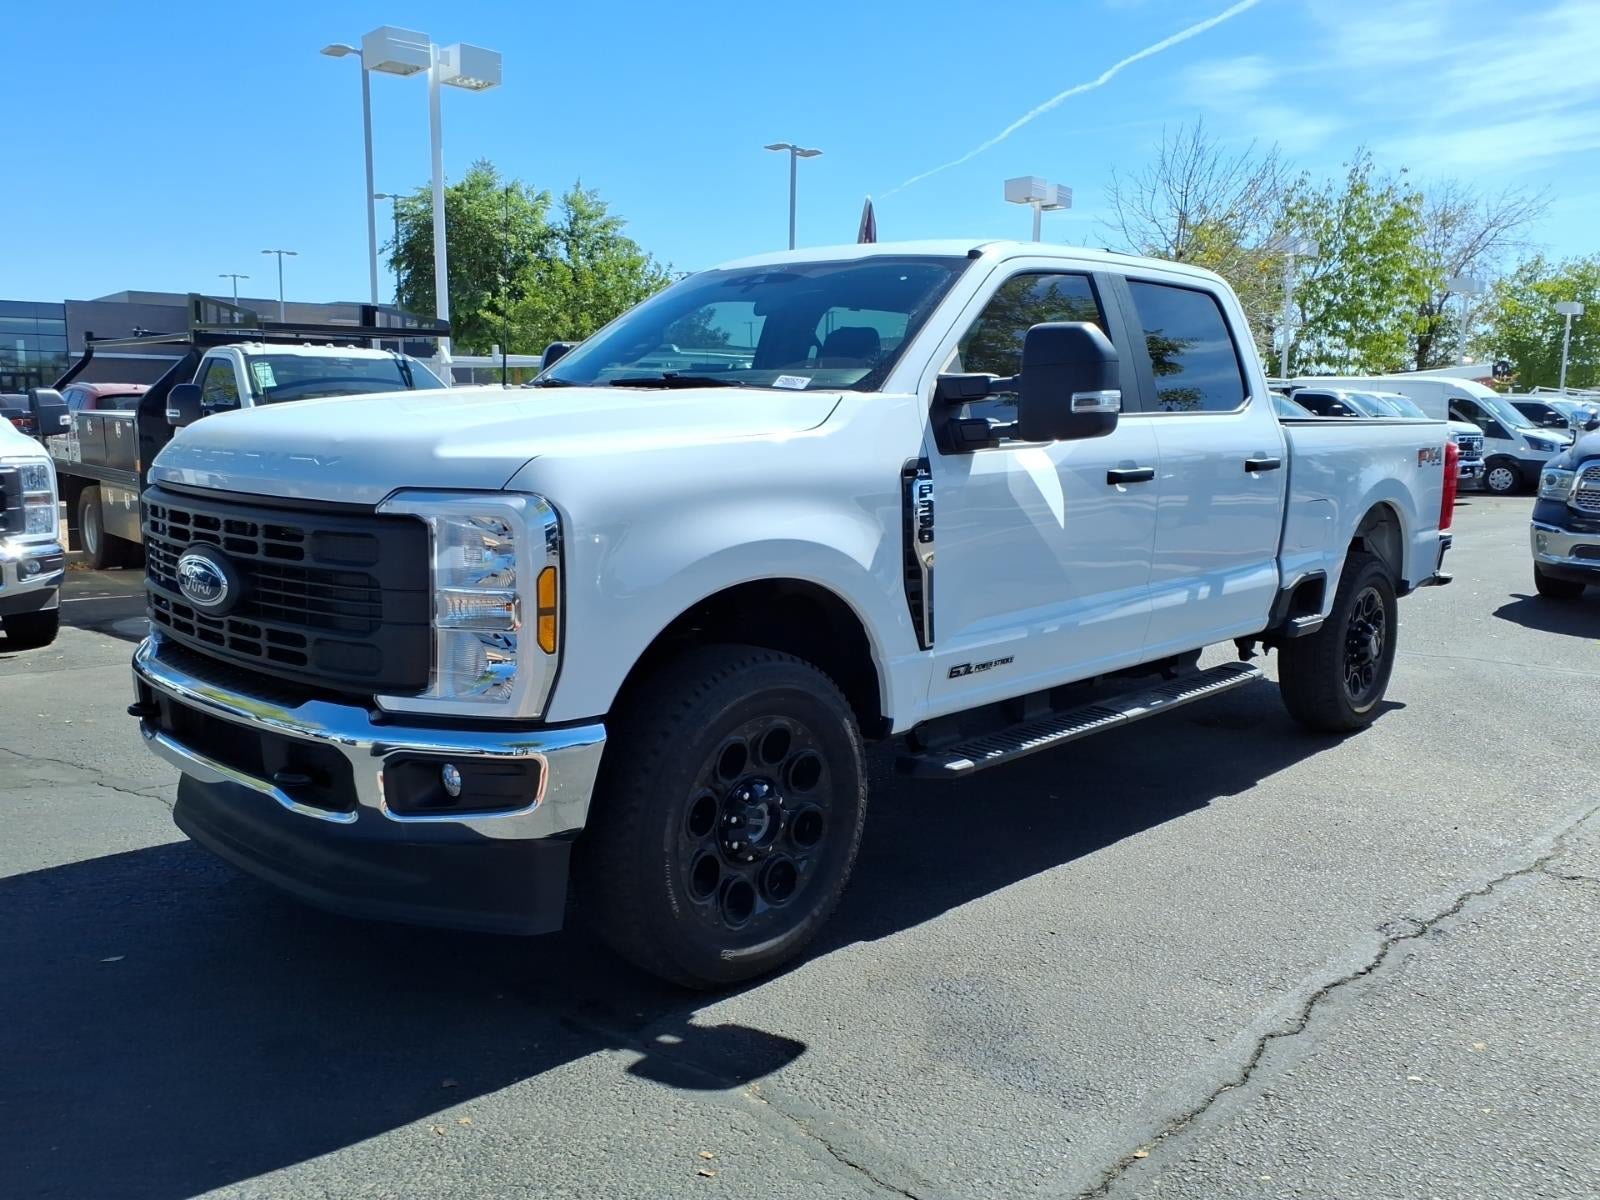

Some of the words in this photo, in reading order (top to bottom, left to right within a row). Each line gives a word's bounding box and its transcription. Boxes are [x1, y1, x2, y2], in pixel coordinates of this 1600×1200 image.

[1417, 447, 1442, 467] FX4
[916, 468, 929, 476] XL
[974, 662, 993, 673] POWER
[993, 656, 1015, 667] STROKE
